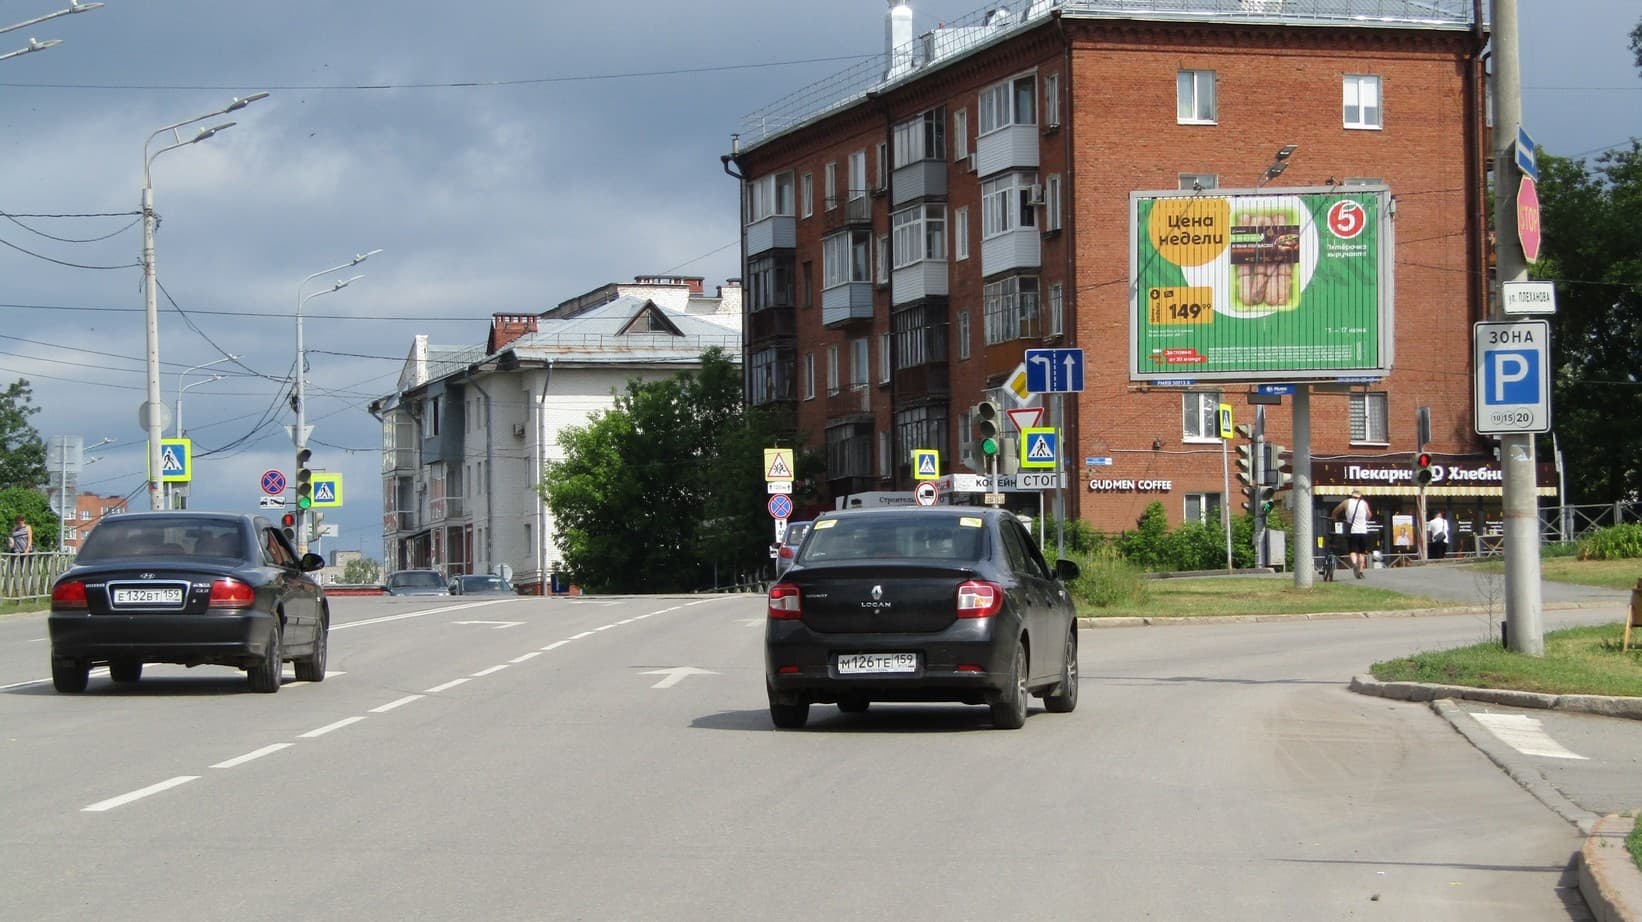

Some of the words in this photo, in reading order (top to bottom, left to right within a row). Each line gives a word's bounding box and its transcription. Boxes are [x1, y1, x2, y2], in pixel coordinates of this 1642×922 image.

[1168, 214, 1214, 230] Цена
[1519, 206, 1538, 233] STOP
[1159, 231, 1223, 246] недели
[1518, 291, 1550, 303] ПЛЕХАНОВА
[1169, 304, 1201, 319] 149
[1489, 330, 1534, 344] ЗОНА
[1493, 413, 1500, 421] 10
[1503, 412, 1513, 422] 15
[1516, 411, 1529, 423] 20
[1090, 480, 1135, 490] GUDMEN
[1138, 480, 1172, 490] COFFEE
[163, 590, 179, 598] 159
[895, 654, 913, 664] 159
